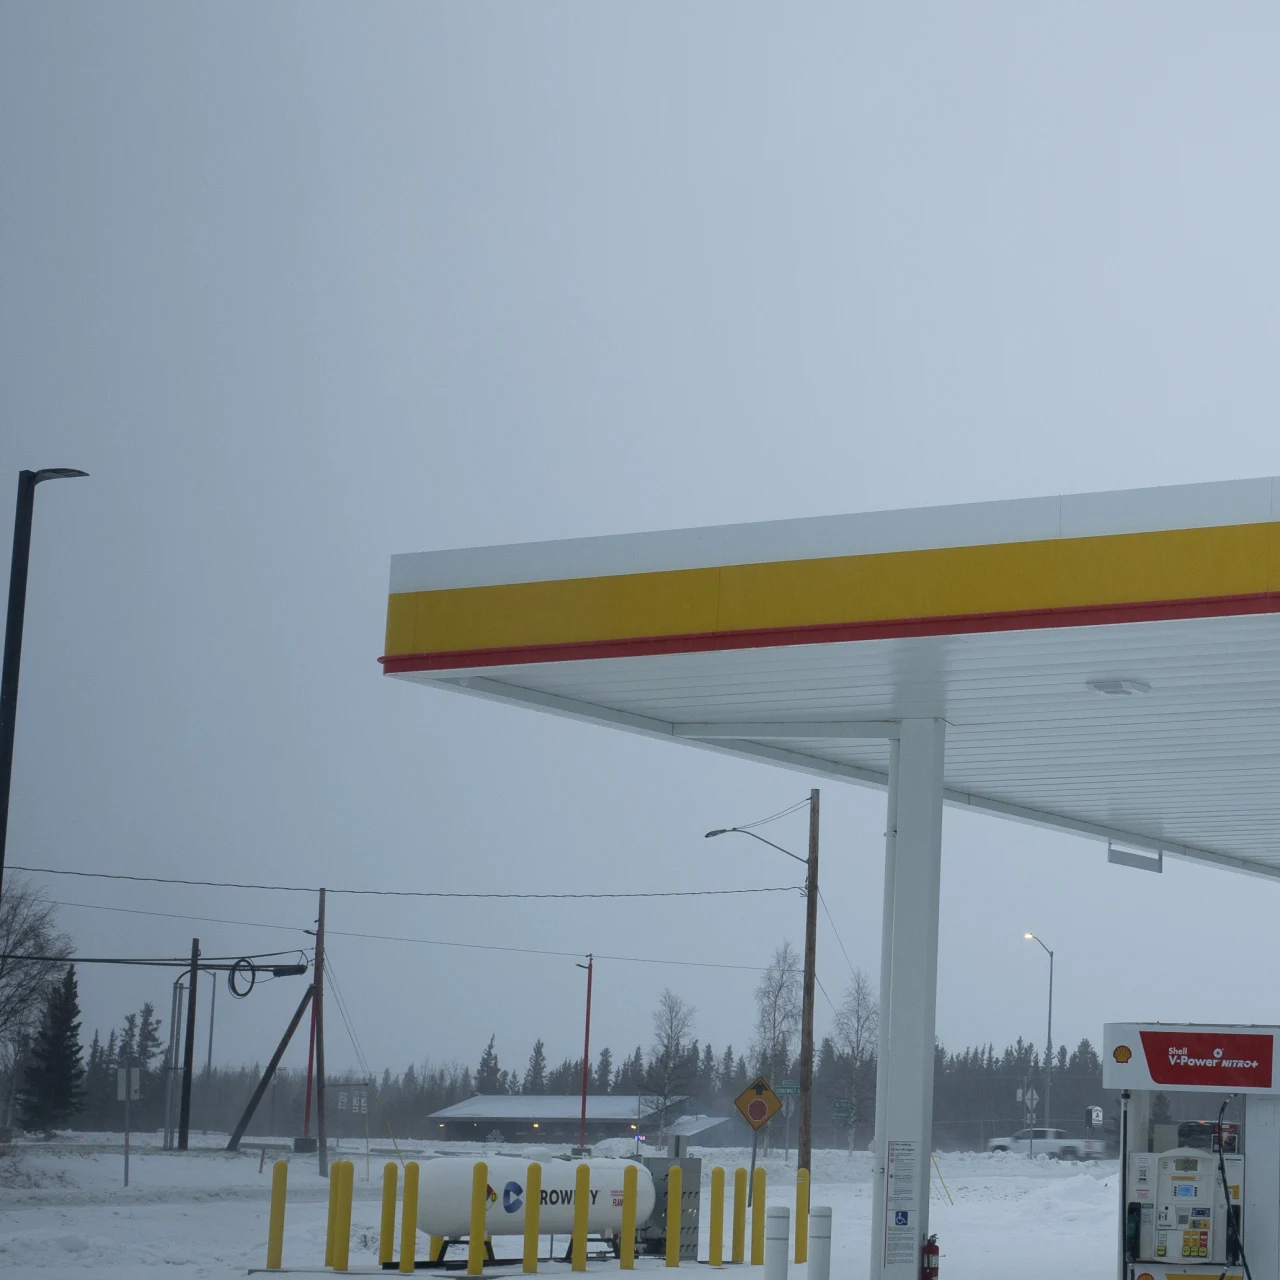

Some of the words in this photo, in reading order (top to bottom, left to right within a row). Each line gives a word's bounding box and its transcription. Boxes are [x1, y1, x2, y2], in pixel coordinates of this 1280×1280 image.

[1168, 1047, 1187, 1055] Shell
[1168, 1056, 1219, 1067] V-Power
[1221, 1060, 1259, 1069] NITRO+
[540, 1189, 598, 1205] ROWY
